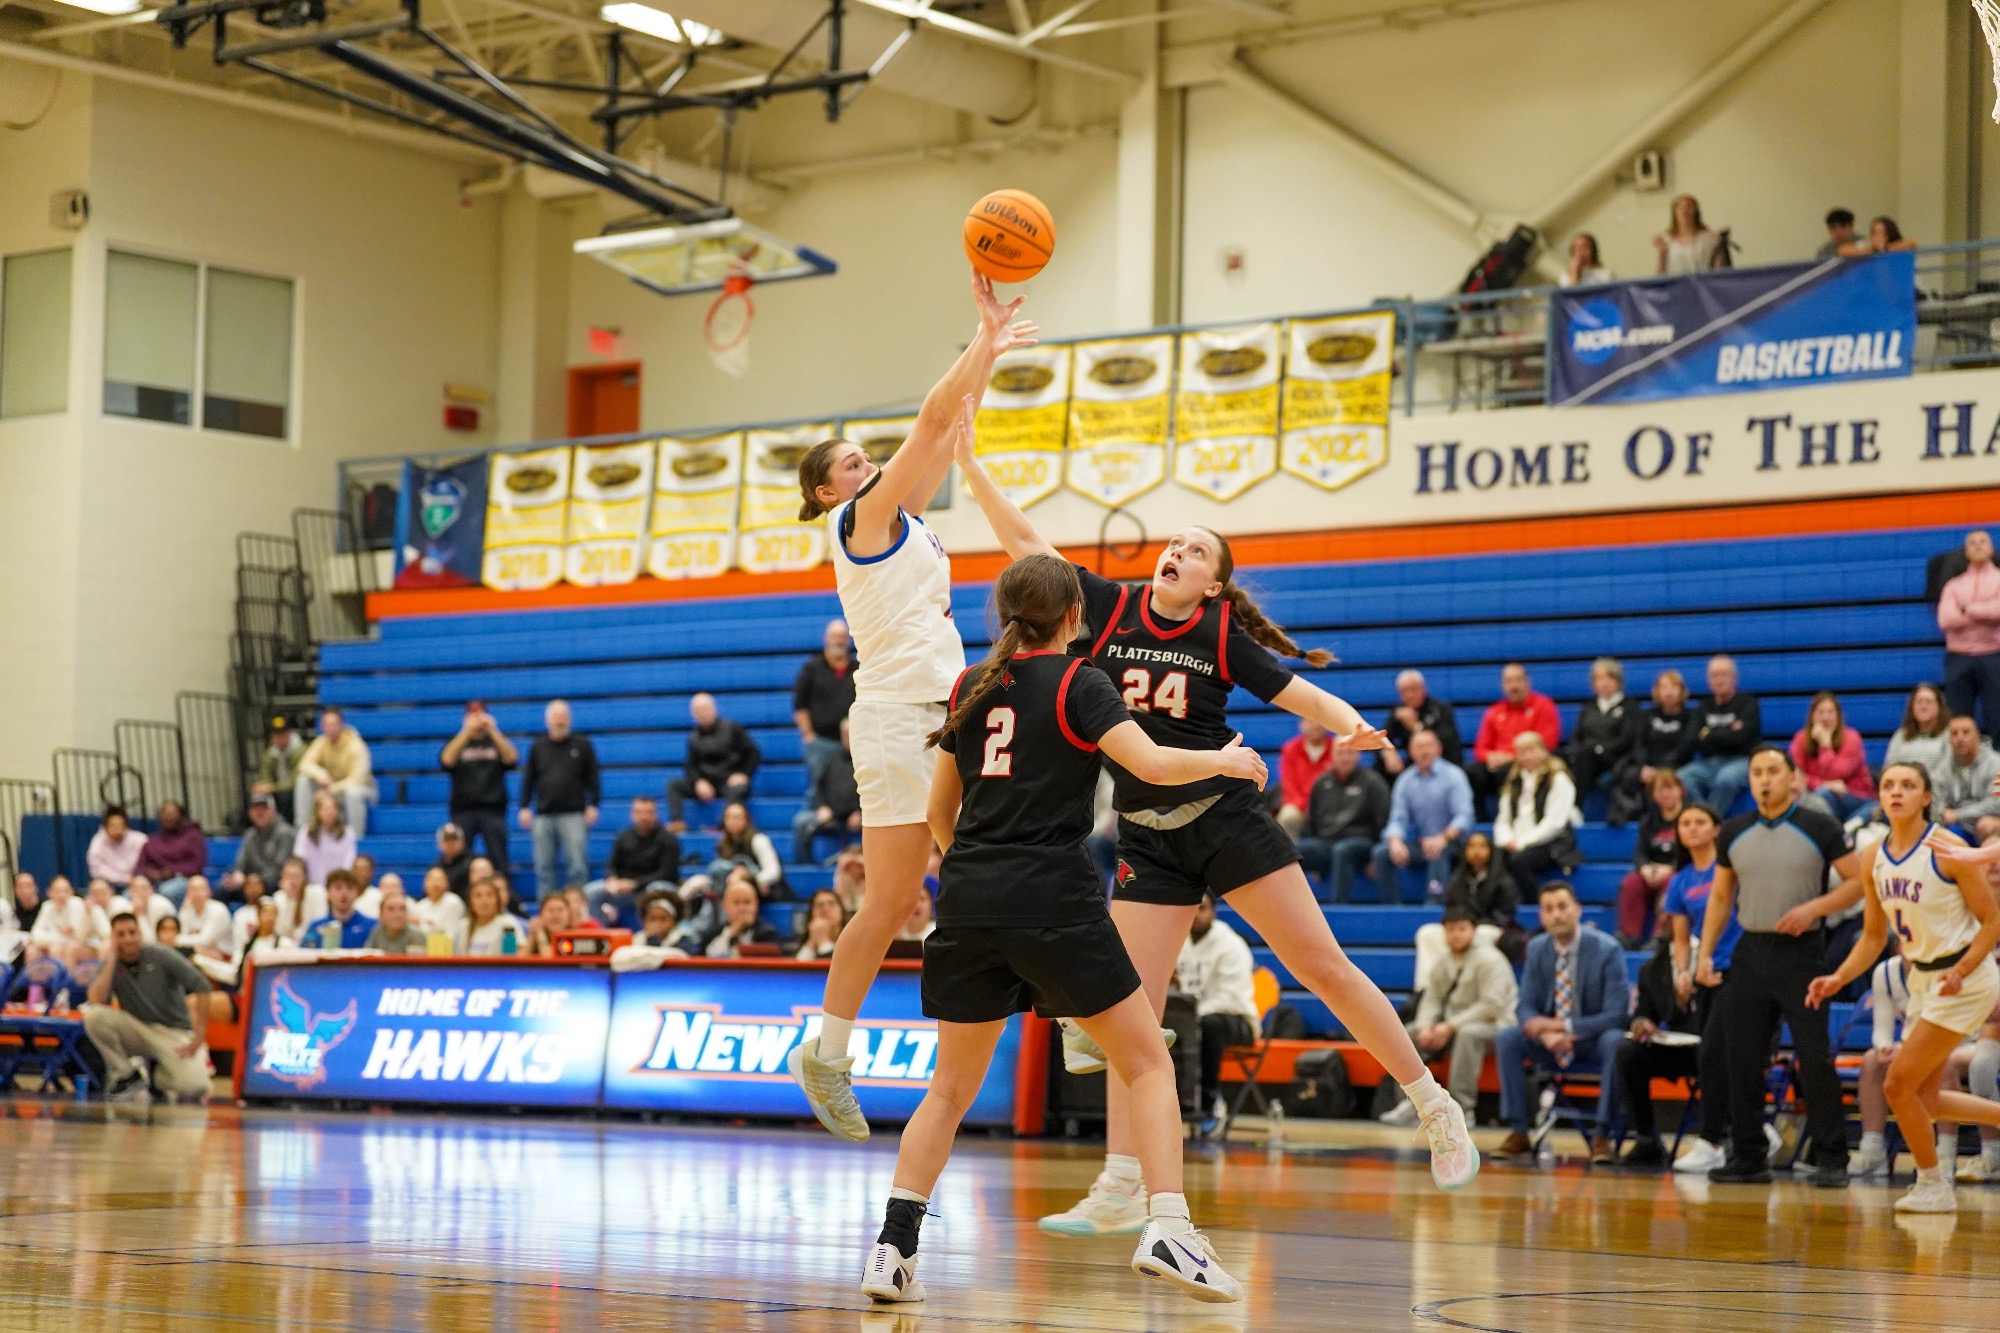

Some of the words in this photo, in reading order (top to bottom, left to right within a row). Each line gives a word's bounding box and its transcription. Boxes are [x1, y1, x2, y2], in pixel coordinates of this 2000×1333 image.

[983, 201, 1038, 238] Wilson
[1716, 330, 1903, 384] BASKETBALL
[1194, 443, 1255, 473] 2021
[1298, 432, 1369, 464] 2022
[1414, 441, 1590, 496] HOME
[1623, 425, 1713, 480] OF
[1746, 412, 1881, 471] THE
[984, 457, 1048, 488] 2020
[754, 533, 811, 563] 2019
[1107, 644, 1214, 676] PLATTSBURGH
[1121, 667, 1189, 720] 24
[981, 706, 1016, 777] 2
[376, 988, 464, 1016] HOME
[464, 989, 506, 1017] OF
[509, 989, 570, 1017] THE
[361, 1028, 567, 1083] HAWKS
